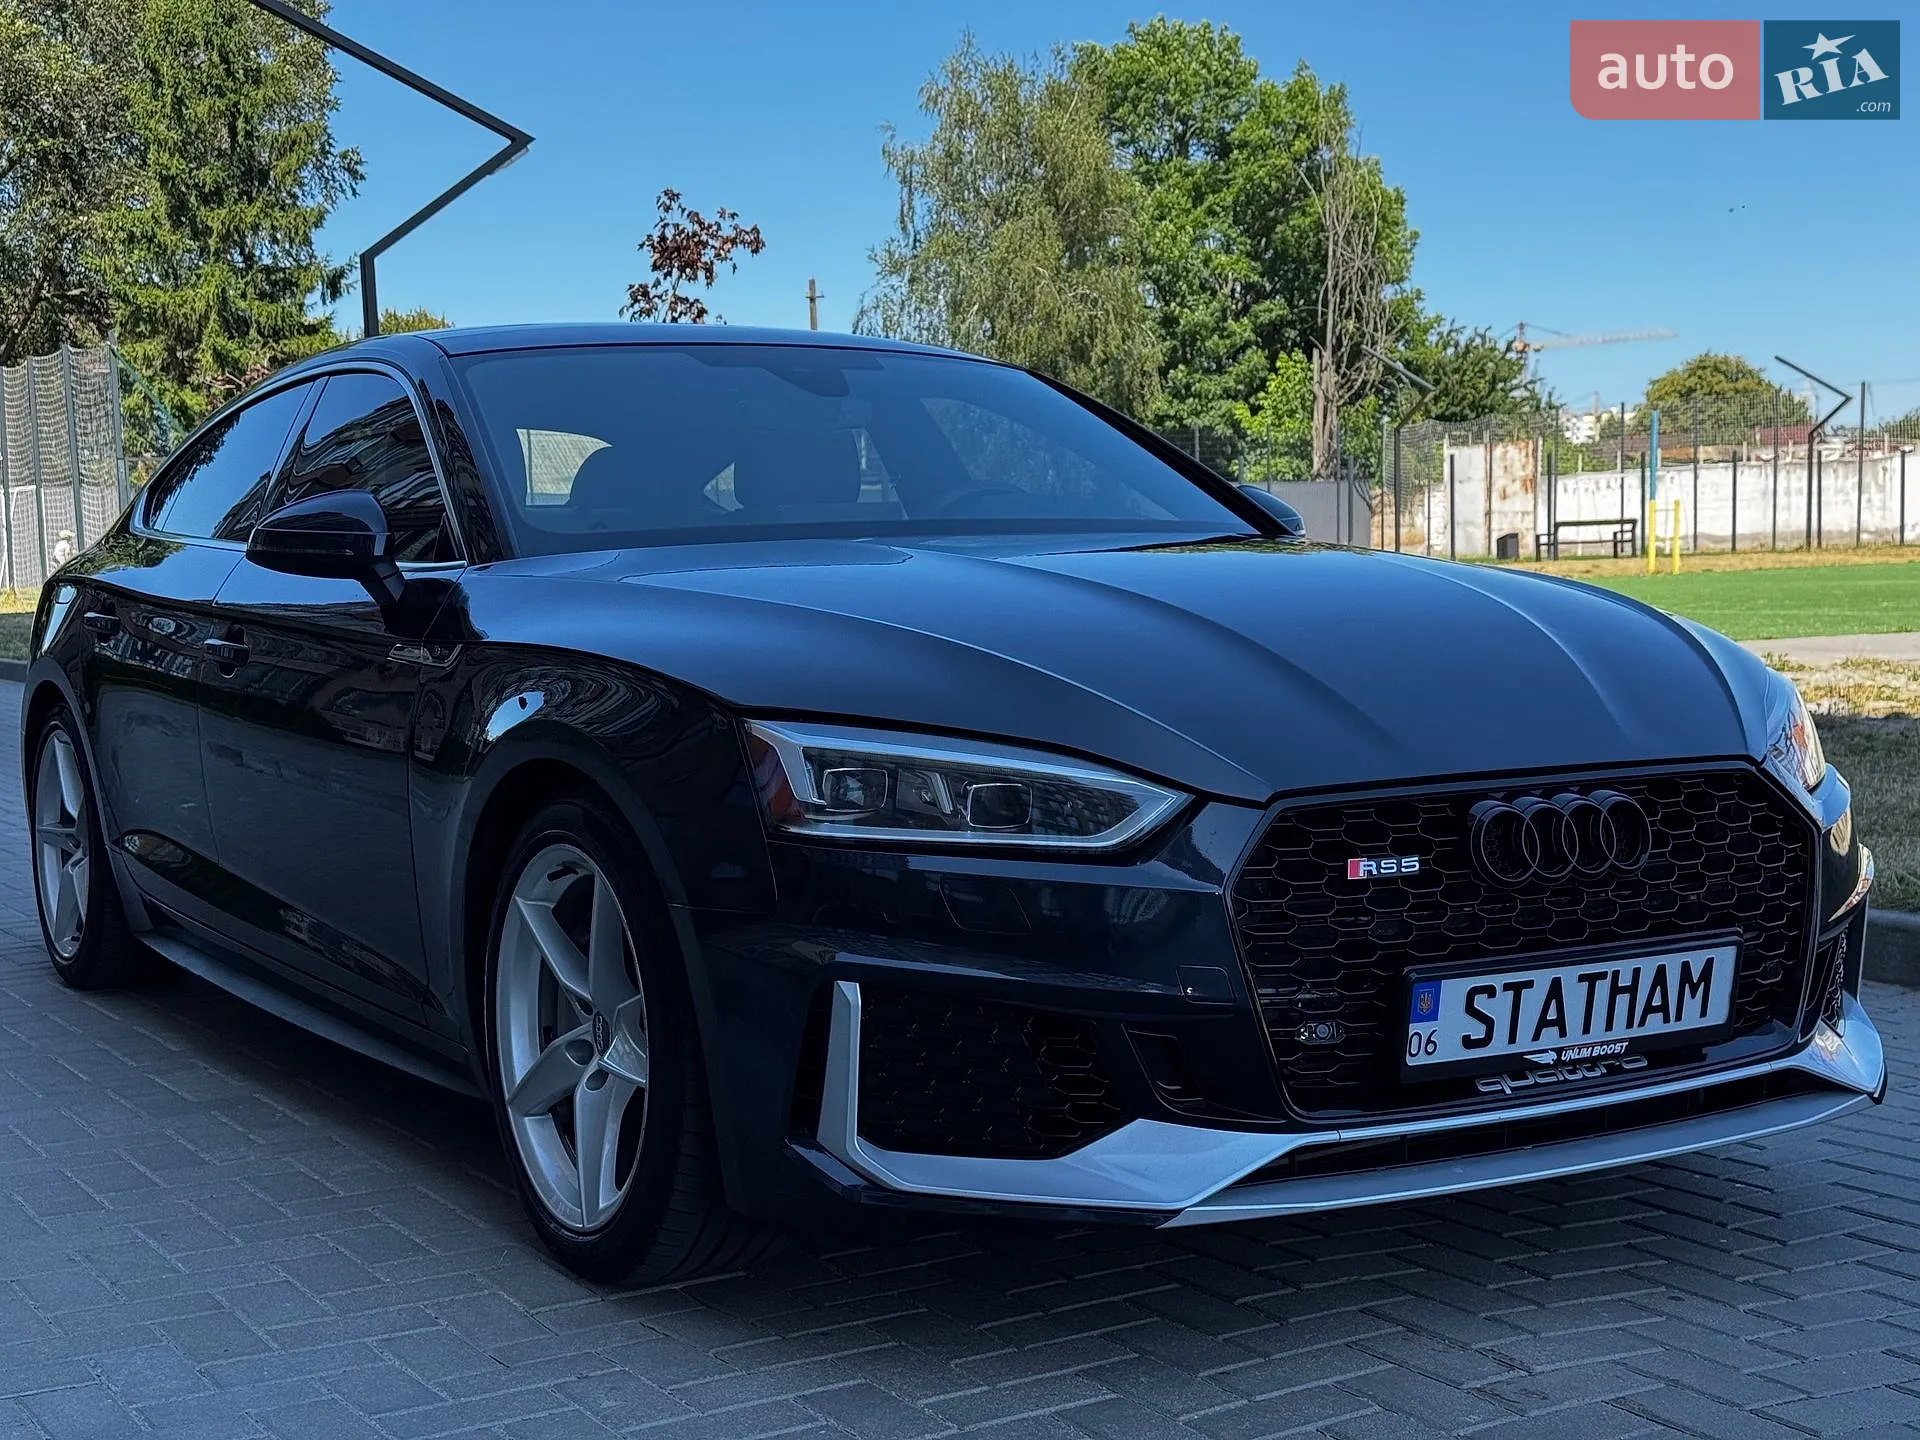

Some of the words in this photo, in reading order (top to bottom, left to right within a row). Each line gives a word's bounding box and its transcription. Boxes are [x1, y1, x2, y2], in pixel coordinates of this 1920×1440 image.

[1359, 857, 1420, 877] RS5
[1461, 956, 1715, 1050] STATHAM
[1408, 1027, 1438, 1058] 06
[1561, 1045, 1592, 1062] UNLIM
[1592, 1042, 1629, 1057] BOOST
[1475, 1054, 1648, 1095] quattro
